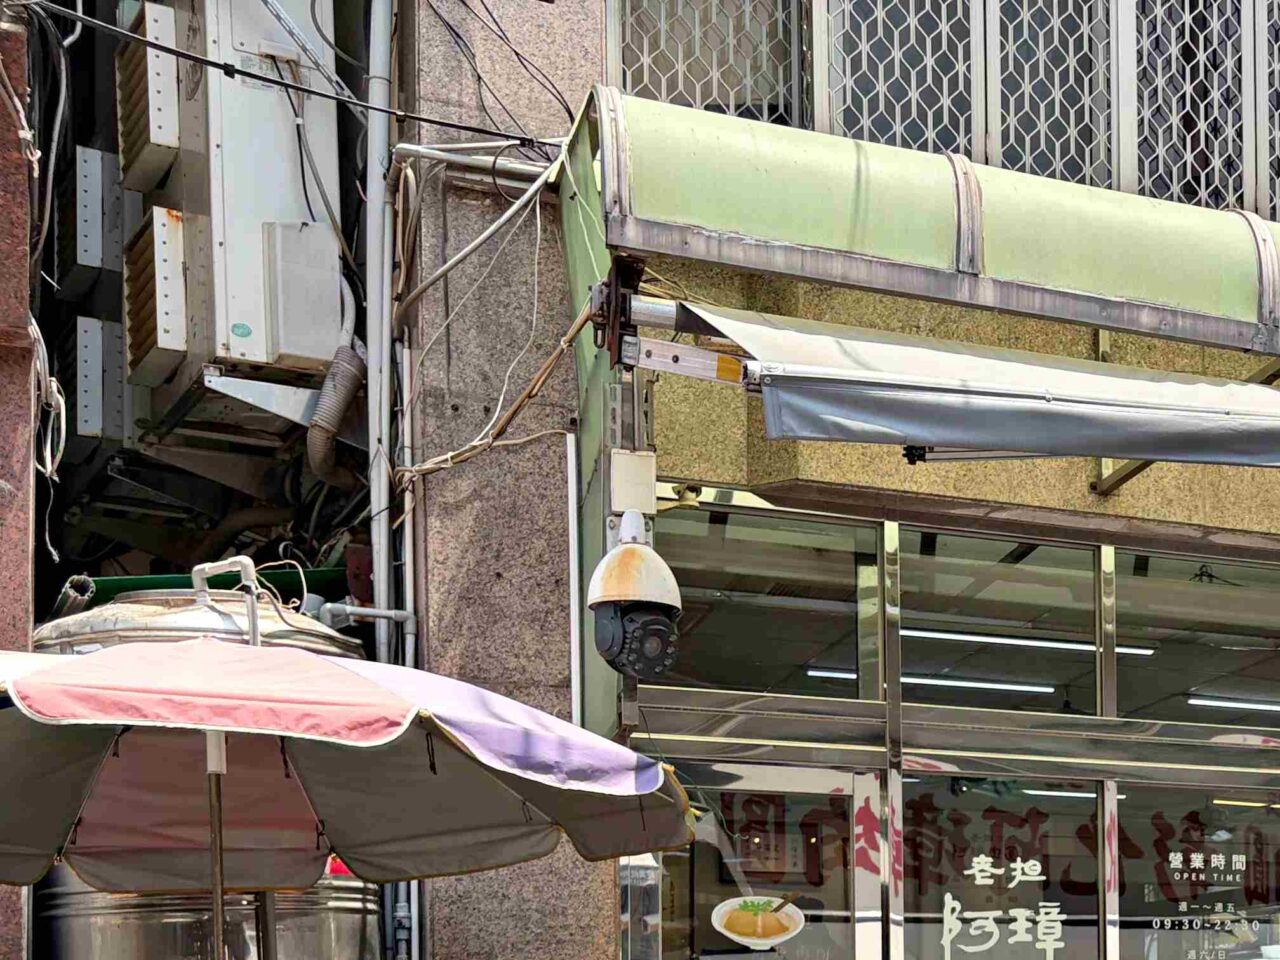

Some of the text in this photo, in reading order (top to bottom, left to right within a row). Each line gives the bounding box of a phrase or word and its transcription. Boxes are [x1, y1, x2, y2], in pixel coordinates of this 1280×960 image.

[1169, 852, 1247, 871] 營業時間
[1174, 872, 1242, 882] OPEN TIME
[1152, 919, 1260, 931] 09:30~22:30
